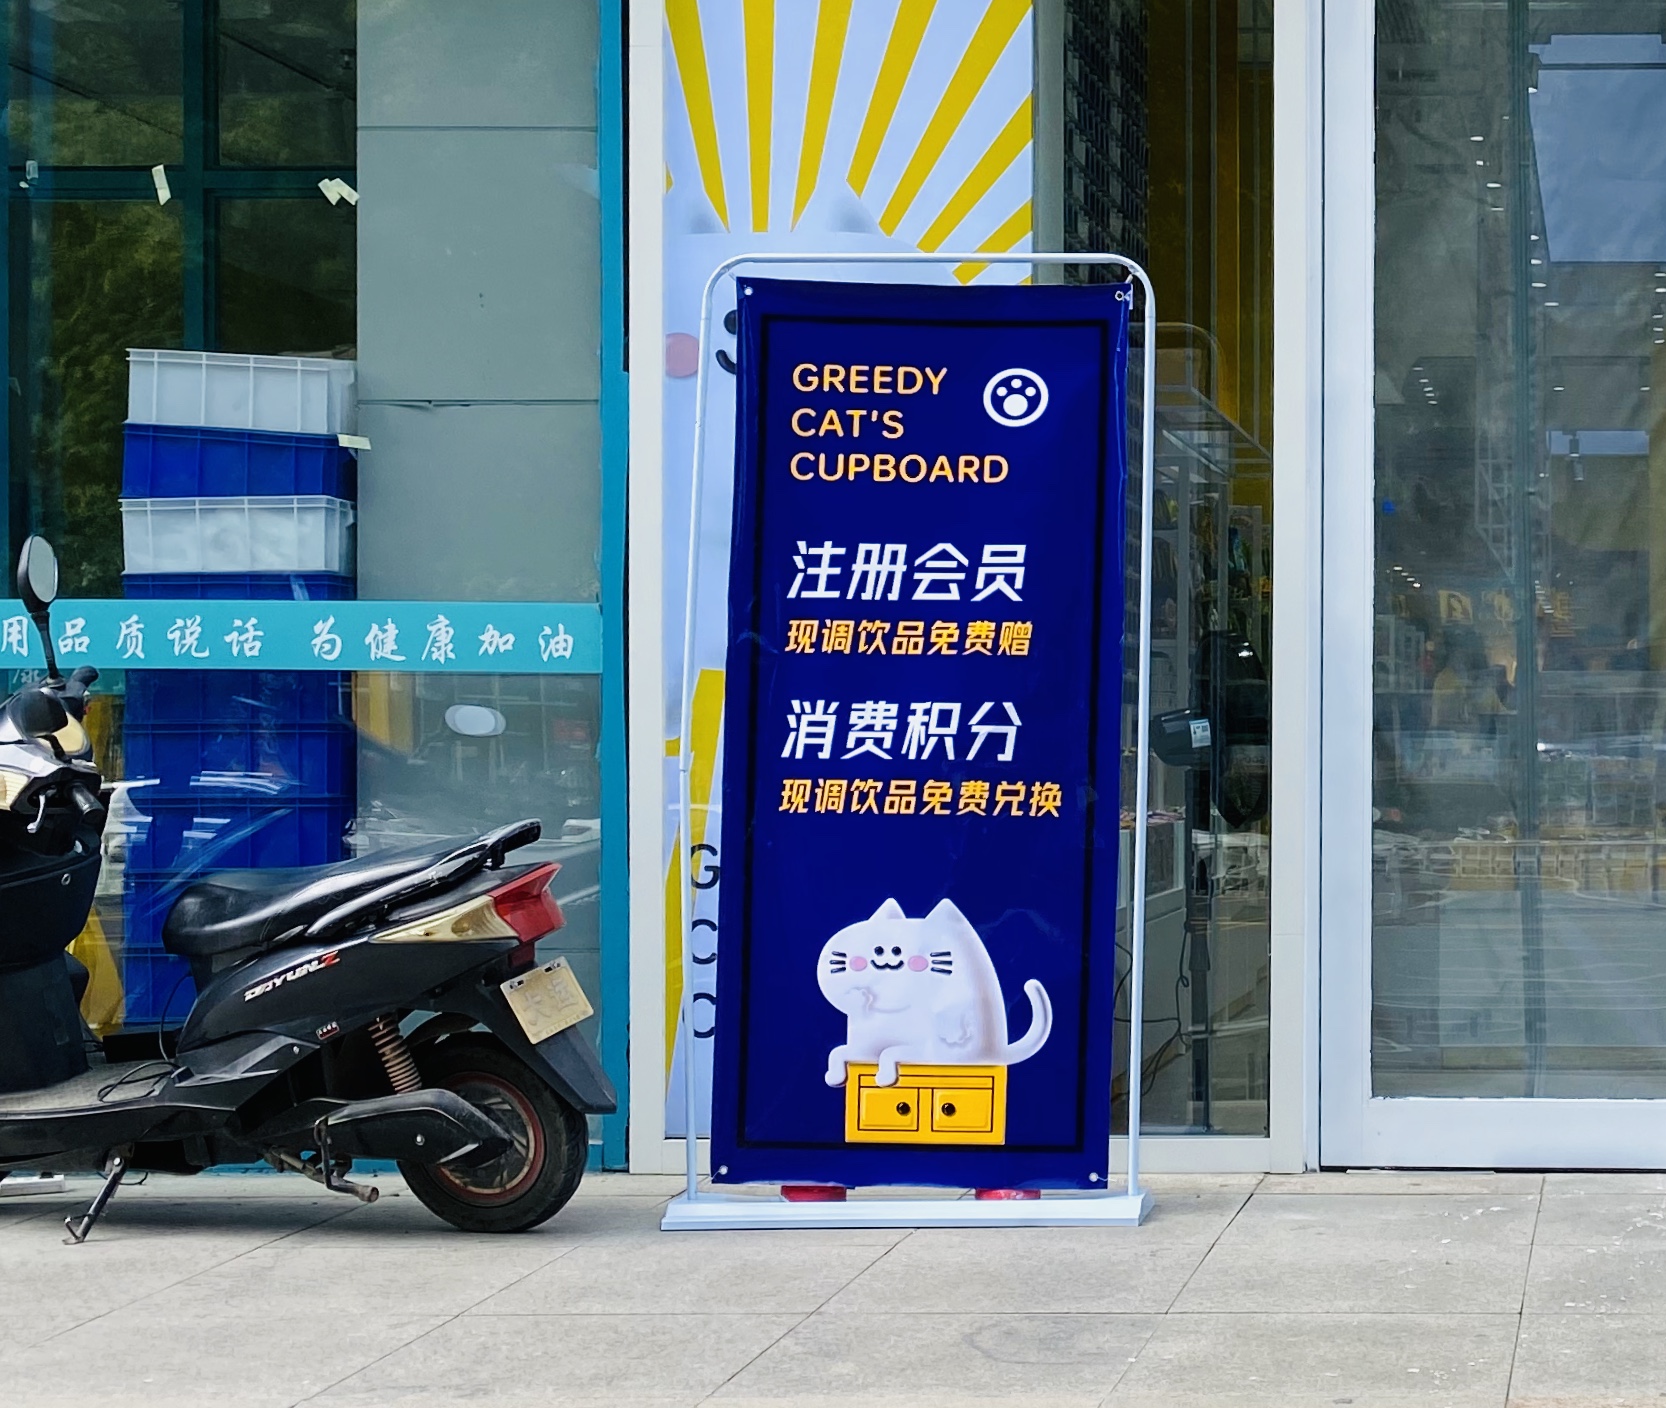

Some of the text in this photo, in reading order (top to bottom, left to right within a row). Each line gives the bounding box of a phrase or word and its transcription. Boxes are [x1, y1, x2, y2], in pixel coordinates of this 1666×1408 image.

[792, 364, 947, 395] GREEDY
[791, 408, 904, 439] CAT'S
[790, 453, 1009, 484] CUPBOARD
[787, 541, 1027, 601] 注册会员
[1, 614, 574, 664] 用品质说话 为健康加油
[784, 620, 1034, 656] 现调饮品免费赠
[780, 700, 1023, 761] 消费积分
[778, 779, 1063, 817] 现调饮品免费兑换
